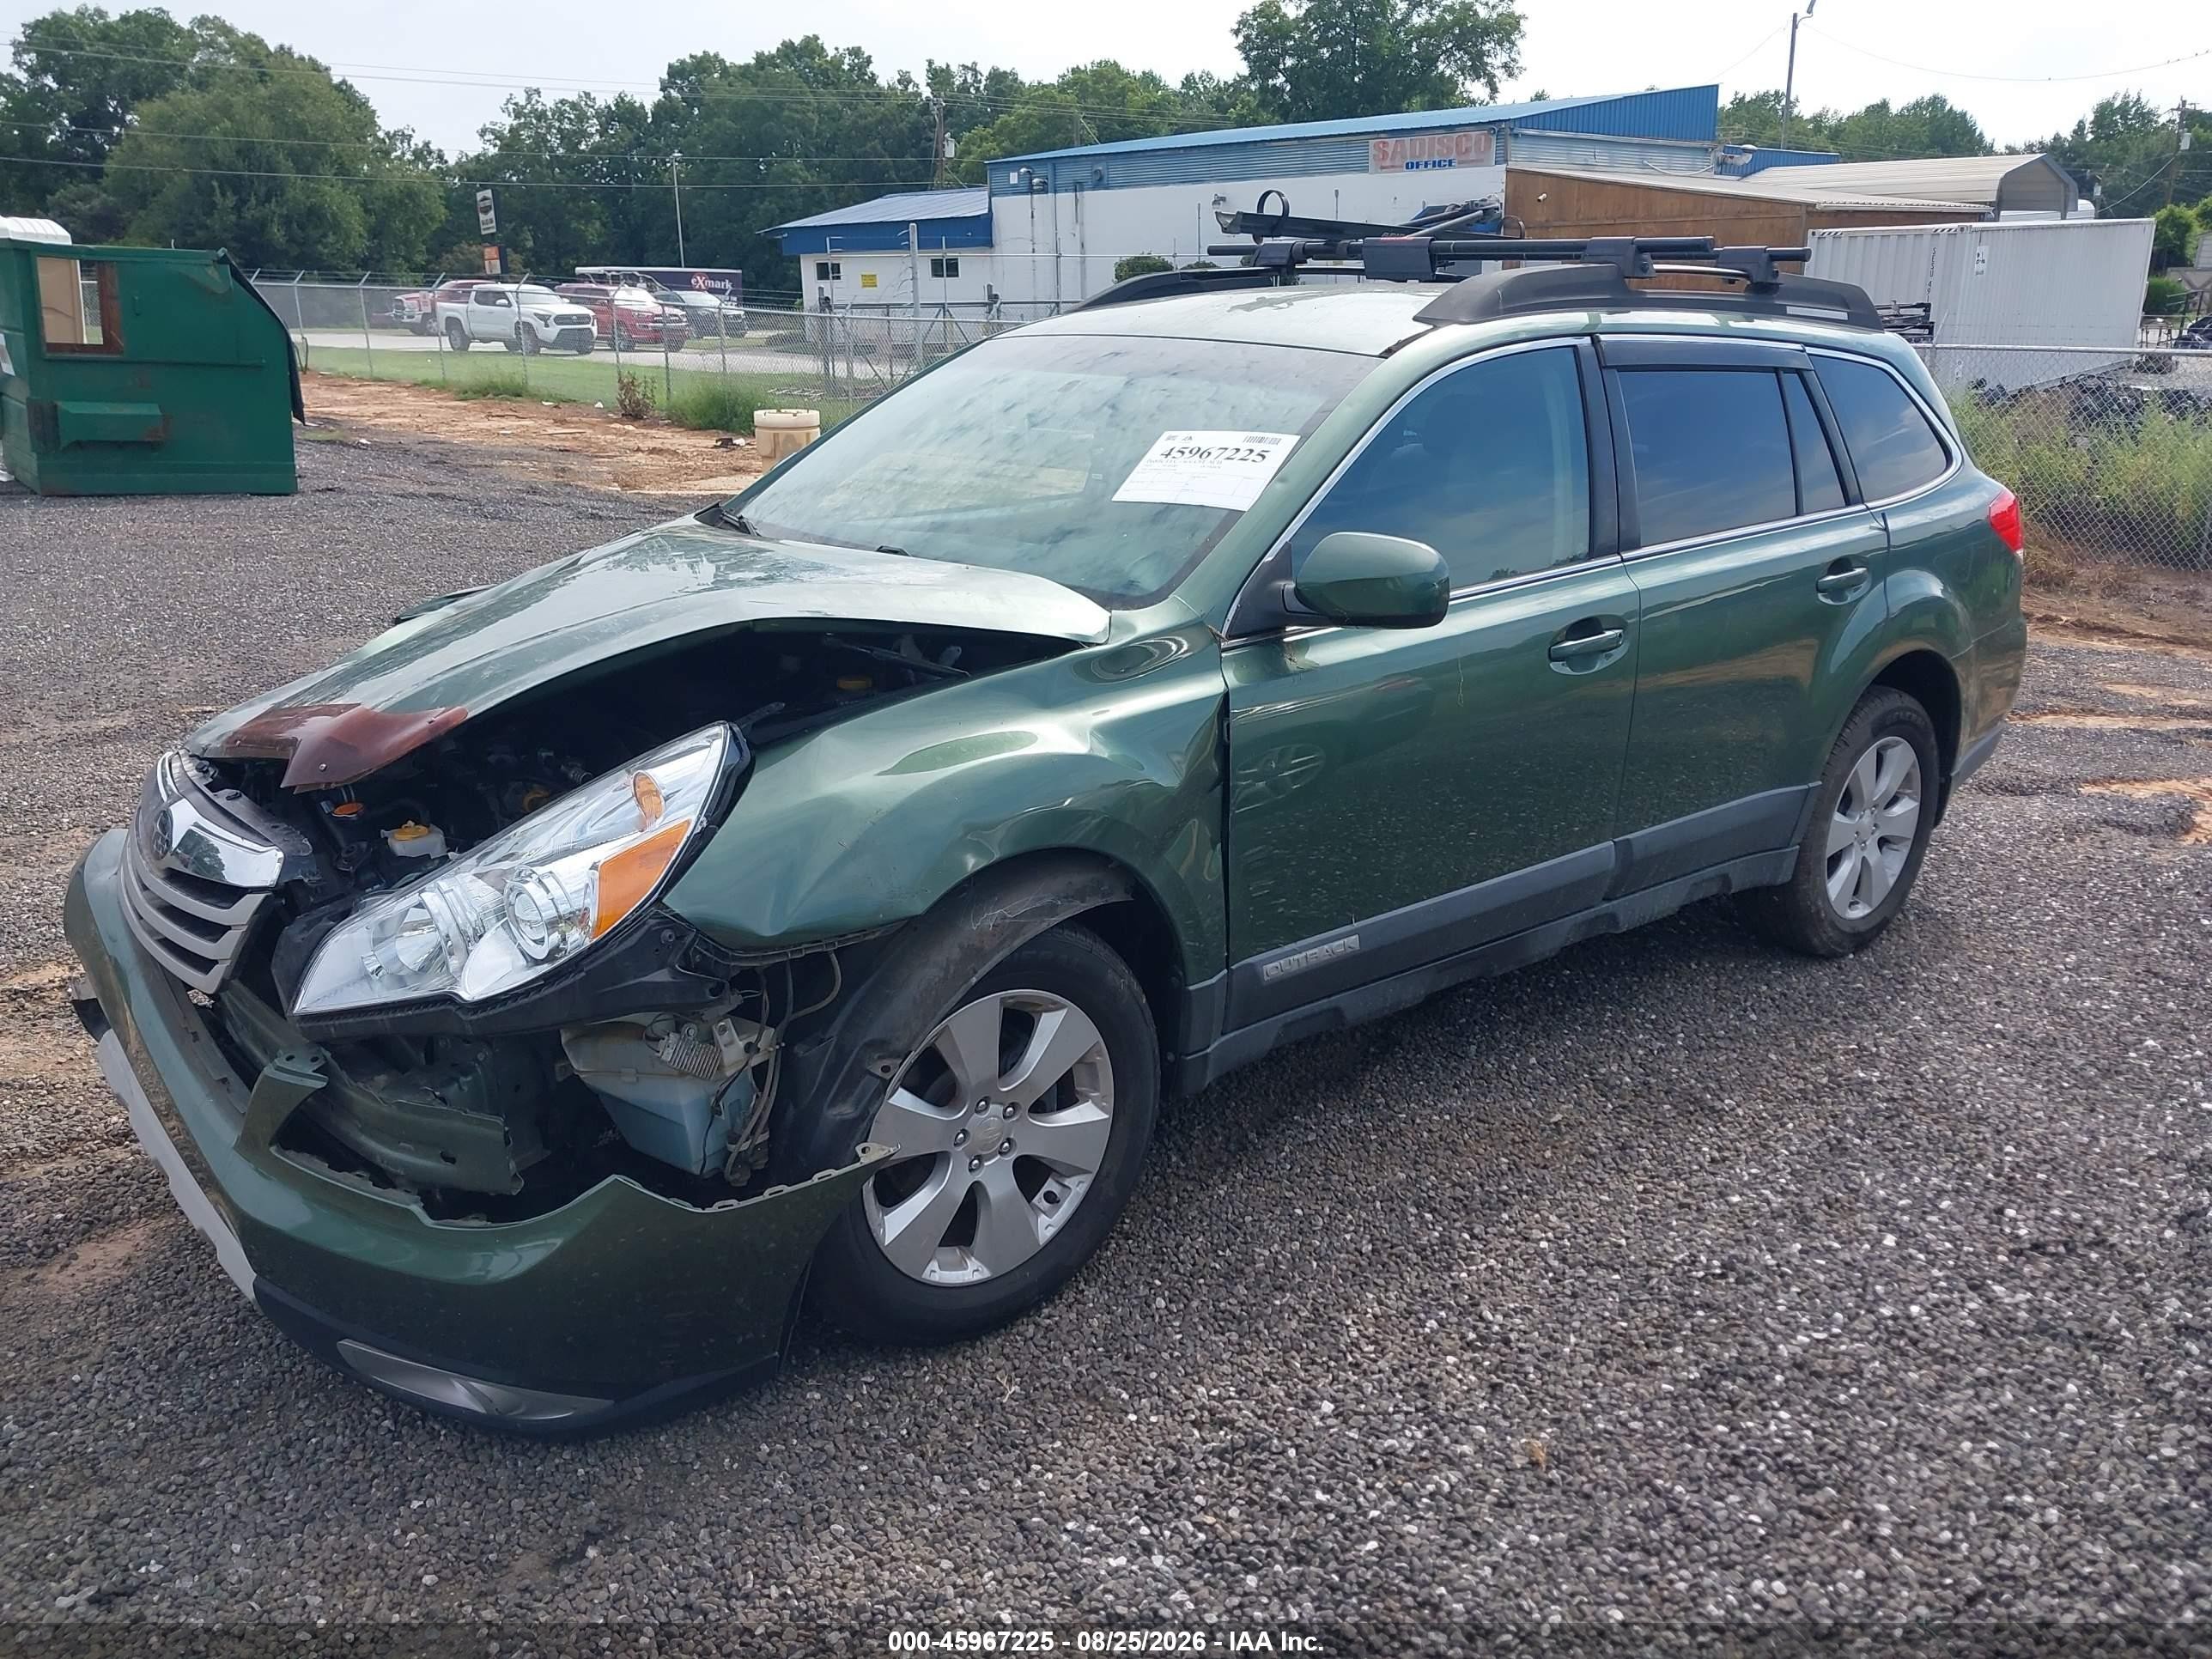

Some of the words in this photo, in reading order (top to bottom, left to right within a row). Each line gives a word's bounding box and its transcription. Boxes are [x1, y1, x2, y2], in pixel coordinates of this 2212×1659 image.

[1373, 132, 1492, 163] SADISCO
[1405, 158, 1457, 170] OFFICE
[690, 275, 733, 290] eXmark
[1160, 441, 1271, 463] 45967225
[1265, 935, 1358, 978] OUTBACK
